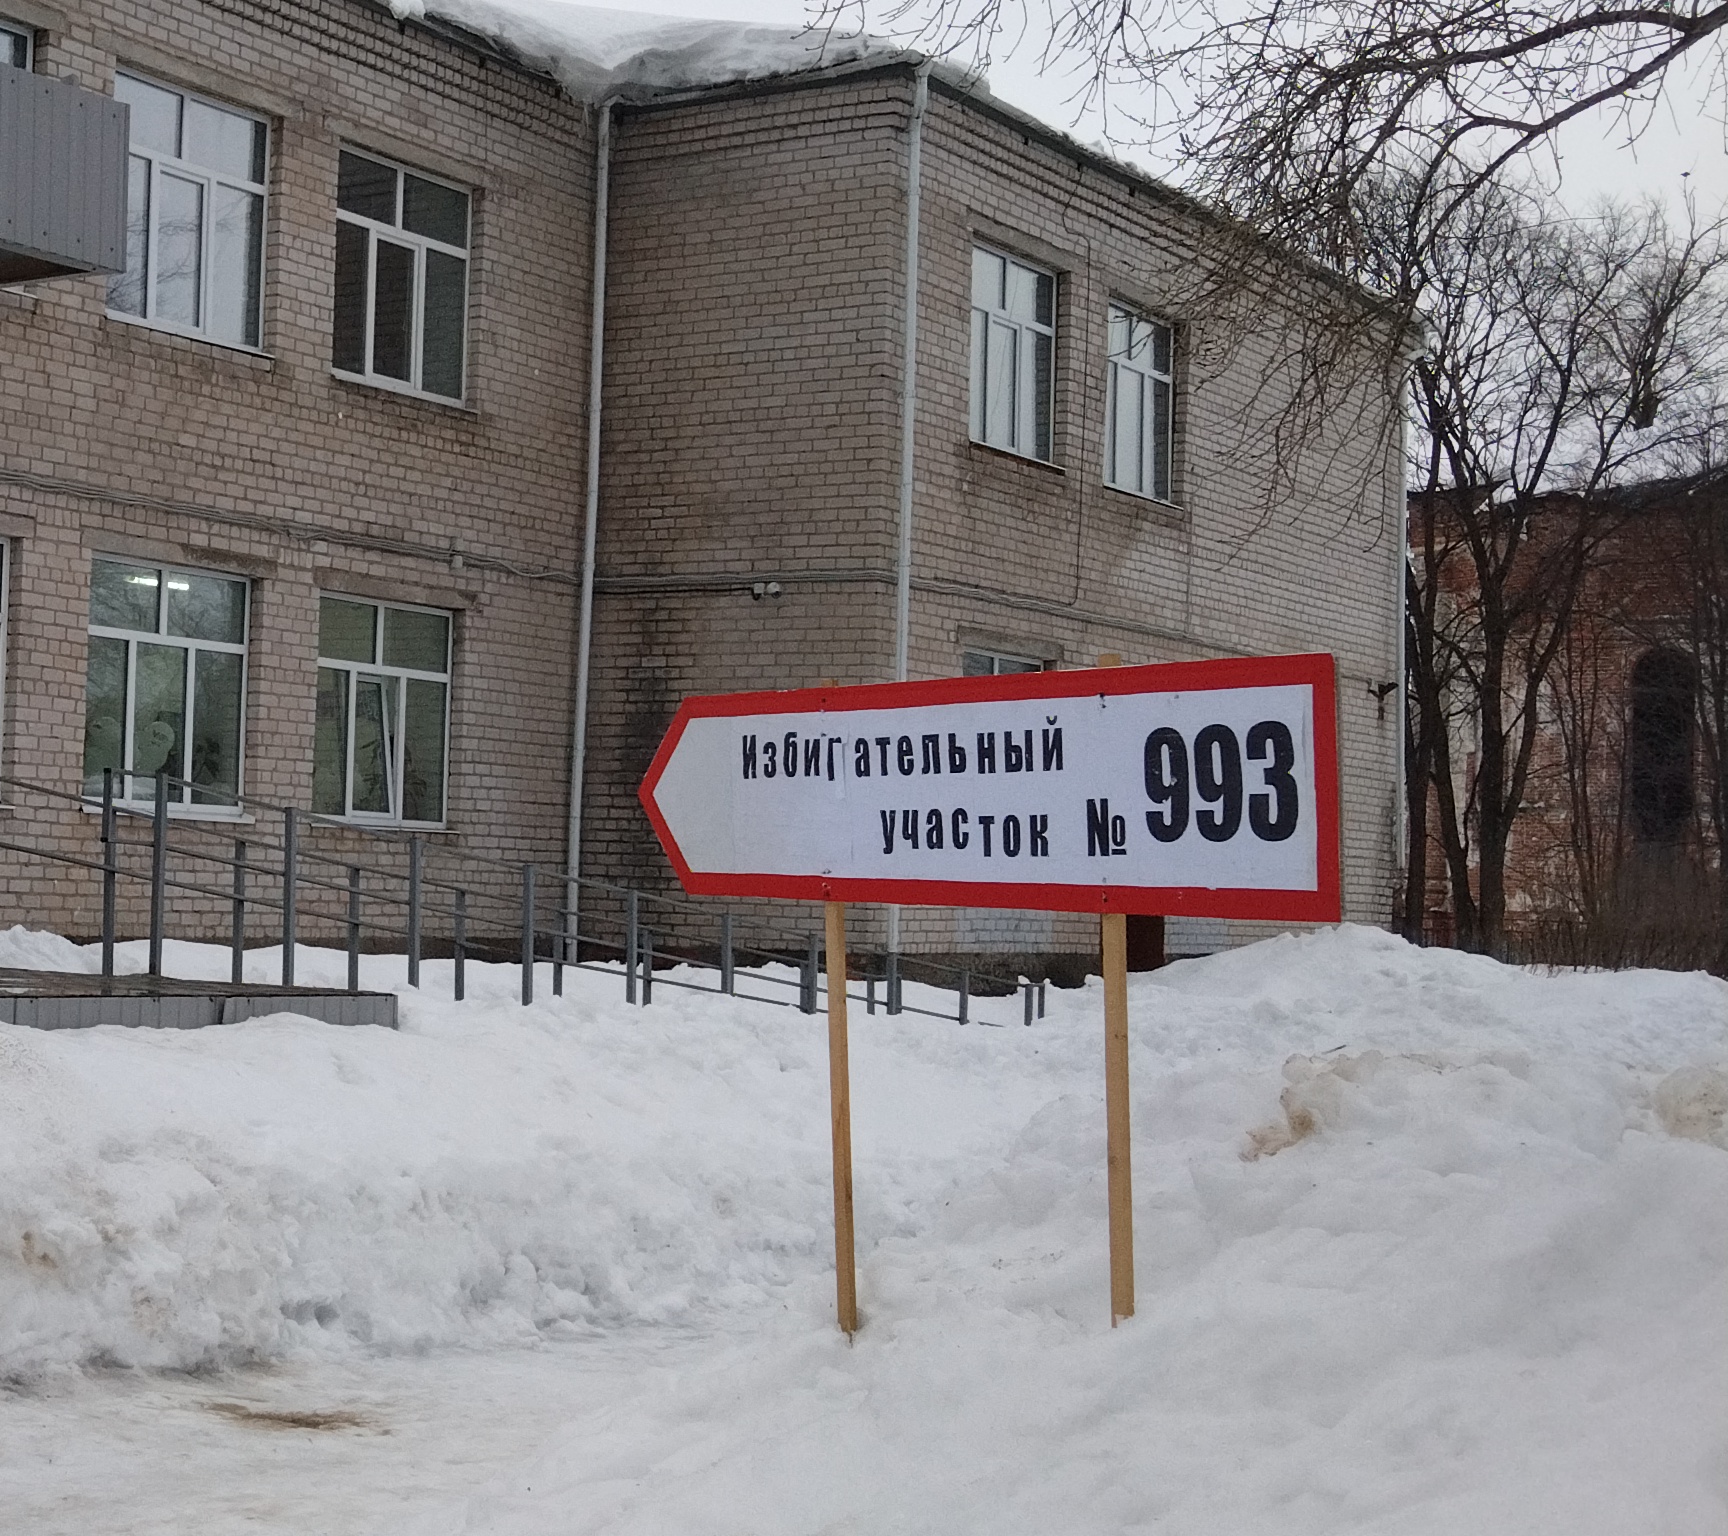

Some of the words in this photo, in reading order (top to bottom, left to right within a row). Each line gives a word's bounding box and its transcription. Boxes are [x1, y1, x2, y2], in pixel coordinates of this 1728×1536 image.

[880, 806, 1049, 857] участок
[1087, 798, 1127, 857] №
[1143, 719, 1300, 843] 993
